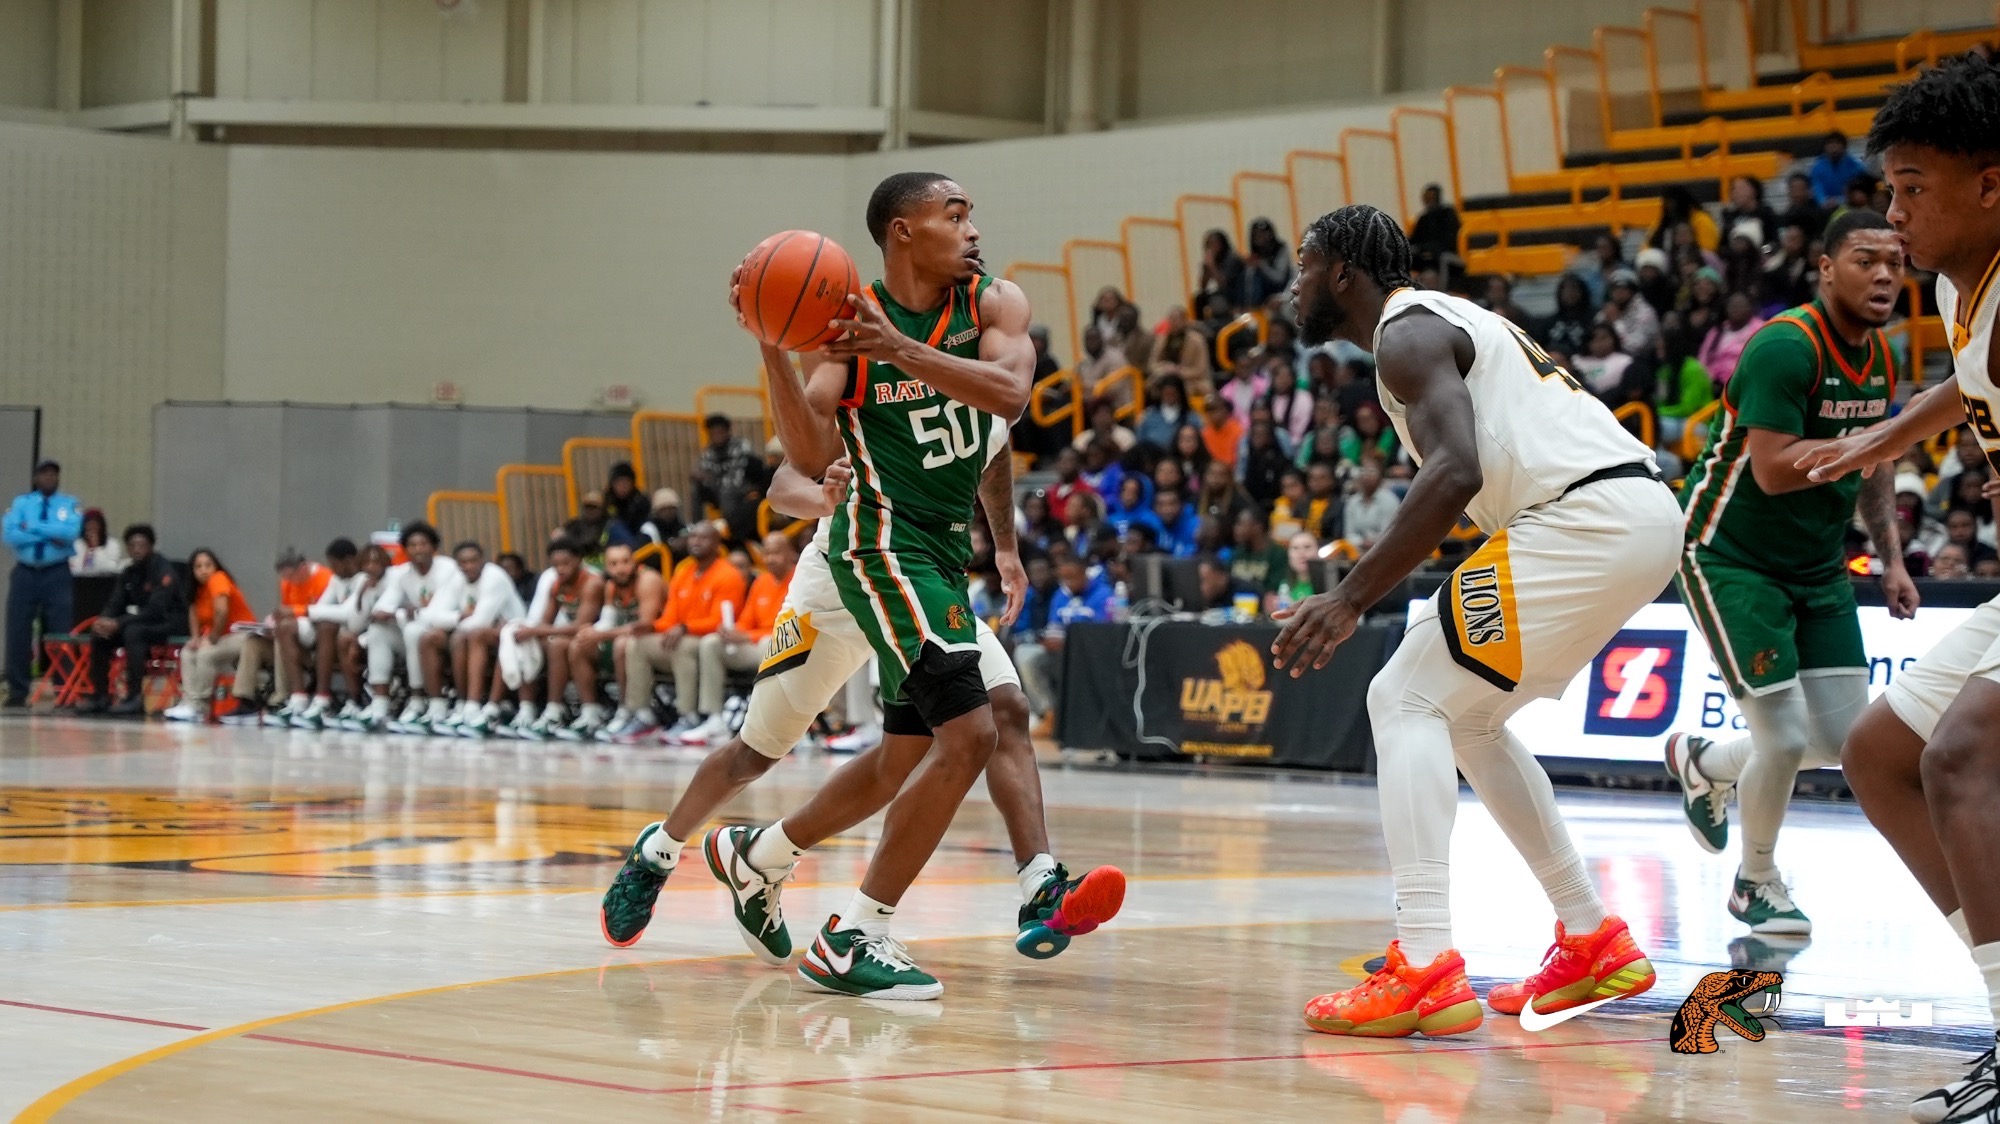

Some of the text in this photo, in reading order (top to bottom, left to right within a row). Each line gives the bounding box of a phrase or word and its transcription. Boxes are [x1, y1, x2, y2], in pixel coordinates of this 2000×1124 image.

[908, 399, 980, 470] 50
[1459, 564, 1506, 647] LIONS
[1180, 678, 1274, 724] UAPB
